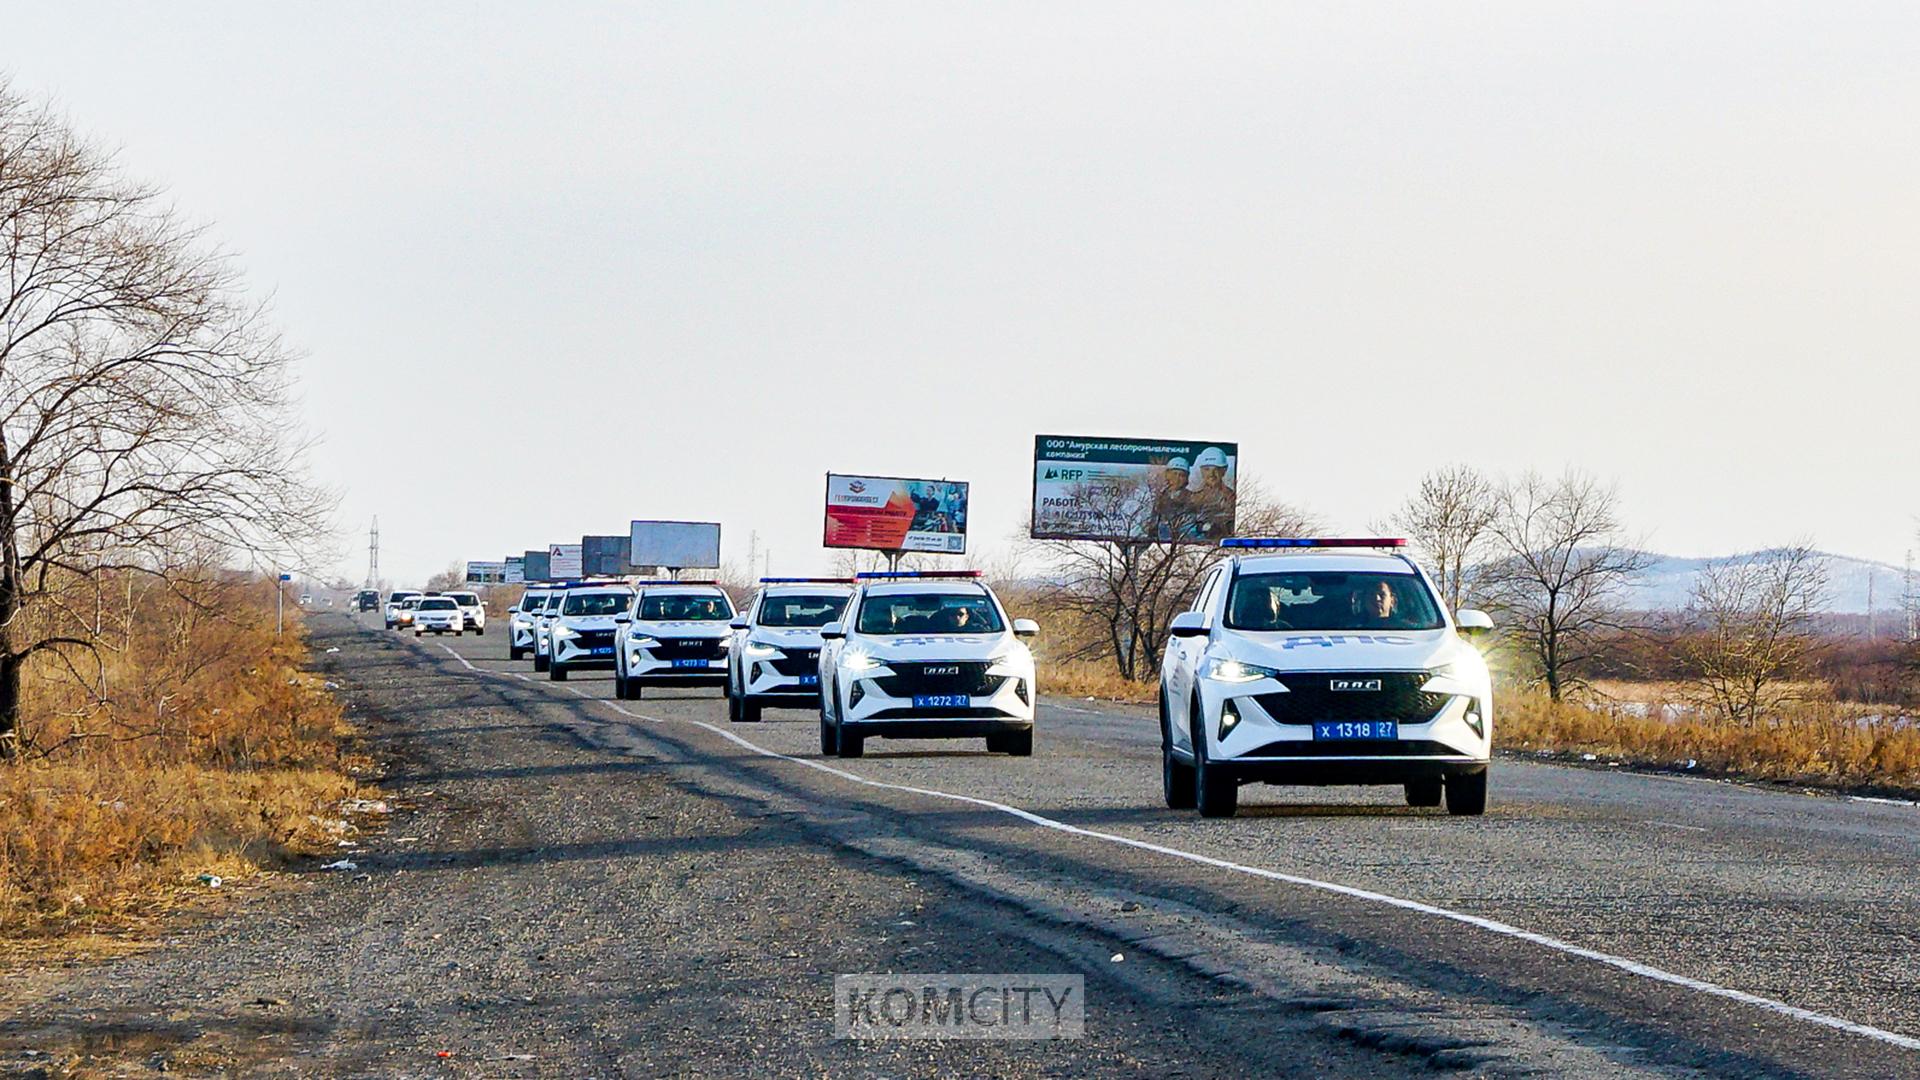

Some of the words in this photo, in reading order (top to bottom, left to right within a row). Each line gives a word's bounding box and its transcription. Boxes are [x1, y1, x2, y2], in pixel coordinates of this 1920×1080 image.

[1061, 469, 1083, 481] RFP
[1282, 634, 1415, 649] ДПС
[928, 695, 952, 706] 1272
[1336, 722, 1371, 738] 1318
[1379, 721, 1393, 732] 27
